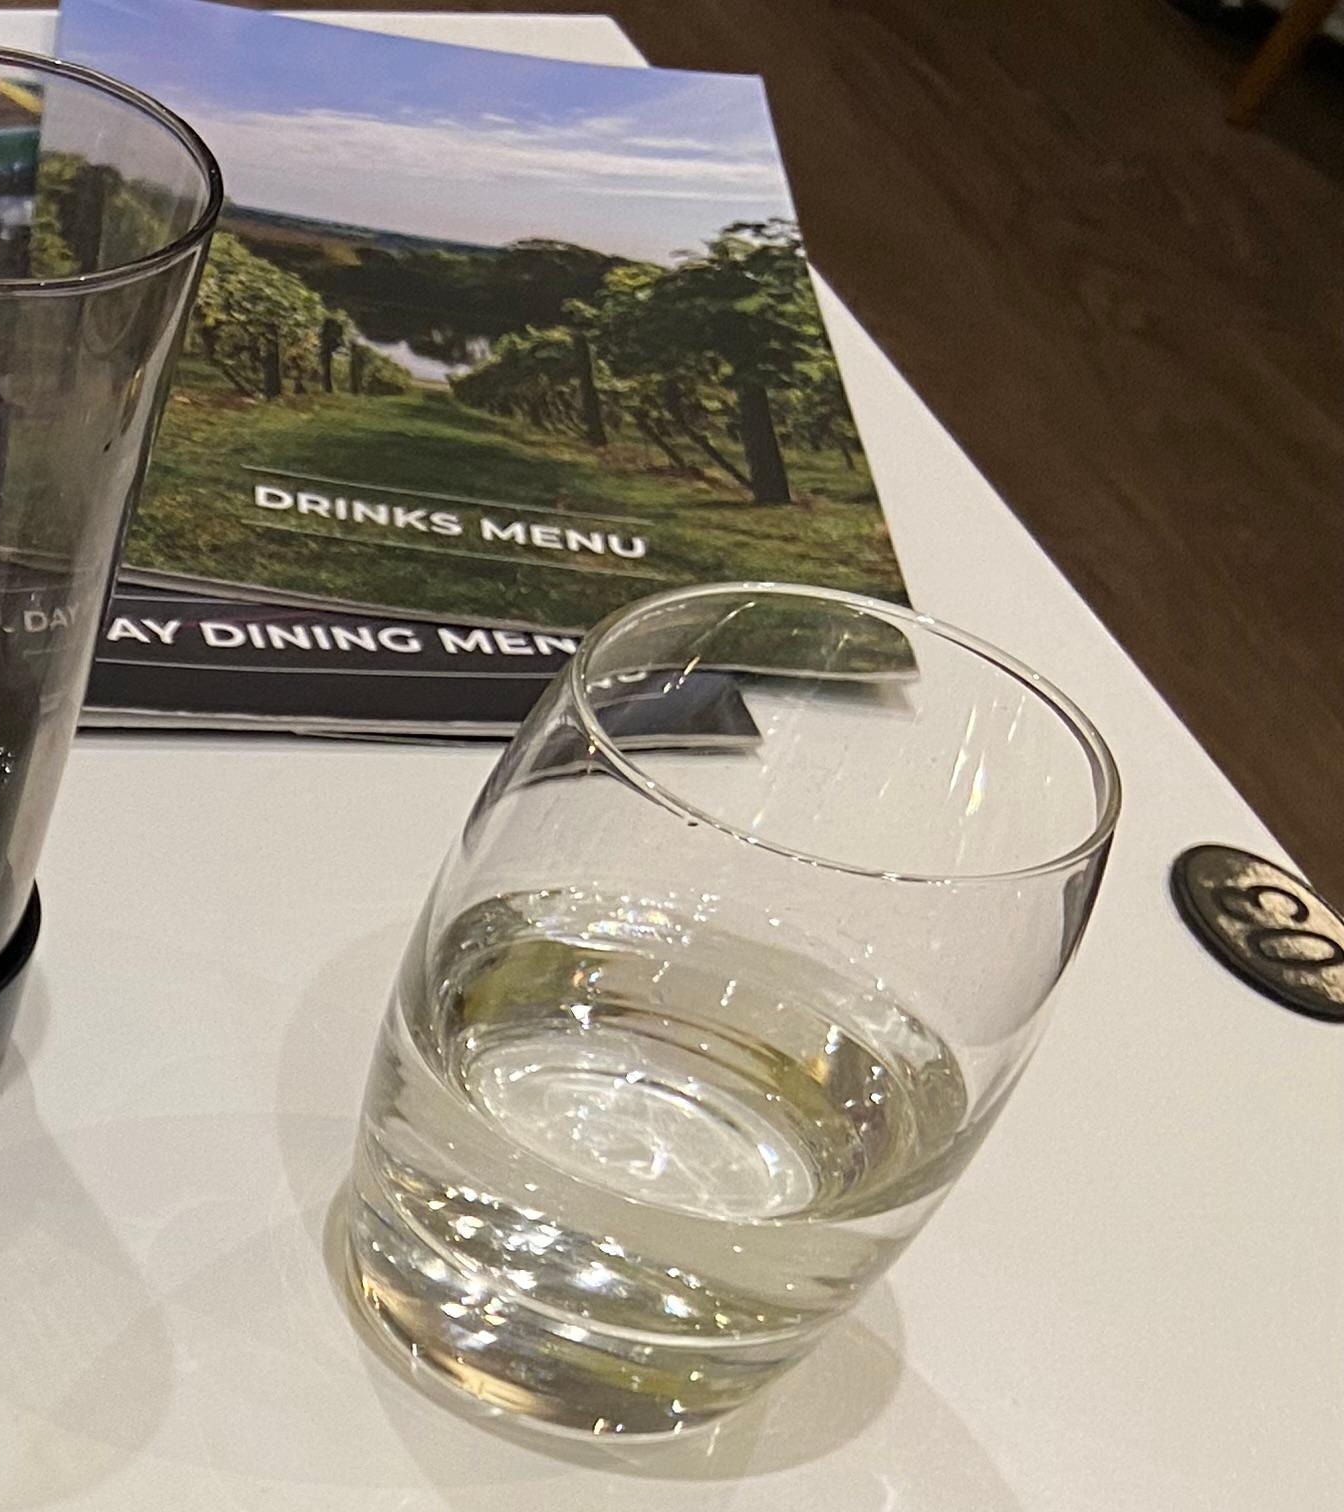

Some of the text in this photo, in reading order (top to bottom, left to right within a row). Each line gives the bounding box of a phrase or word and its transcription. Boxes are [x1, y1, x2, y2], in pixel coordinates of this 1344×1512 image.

[253, 485, 647, 560] DRINKS MENU
[106, 617, 180, 648] AY
[199, 620, 422, 655] DINING
